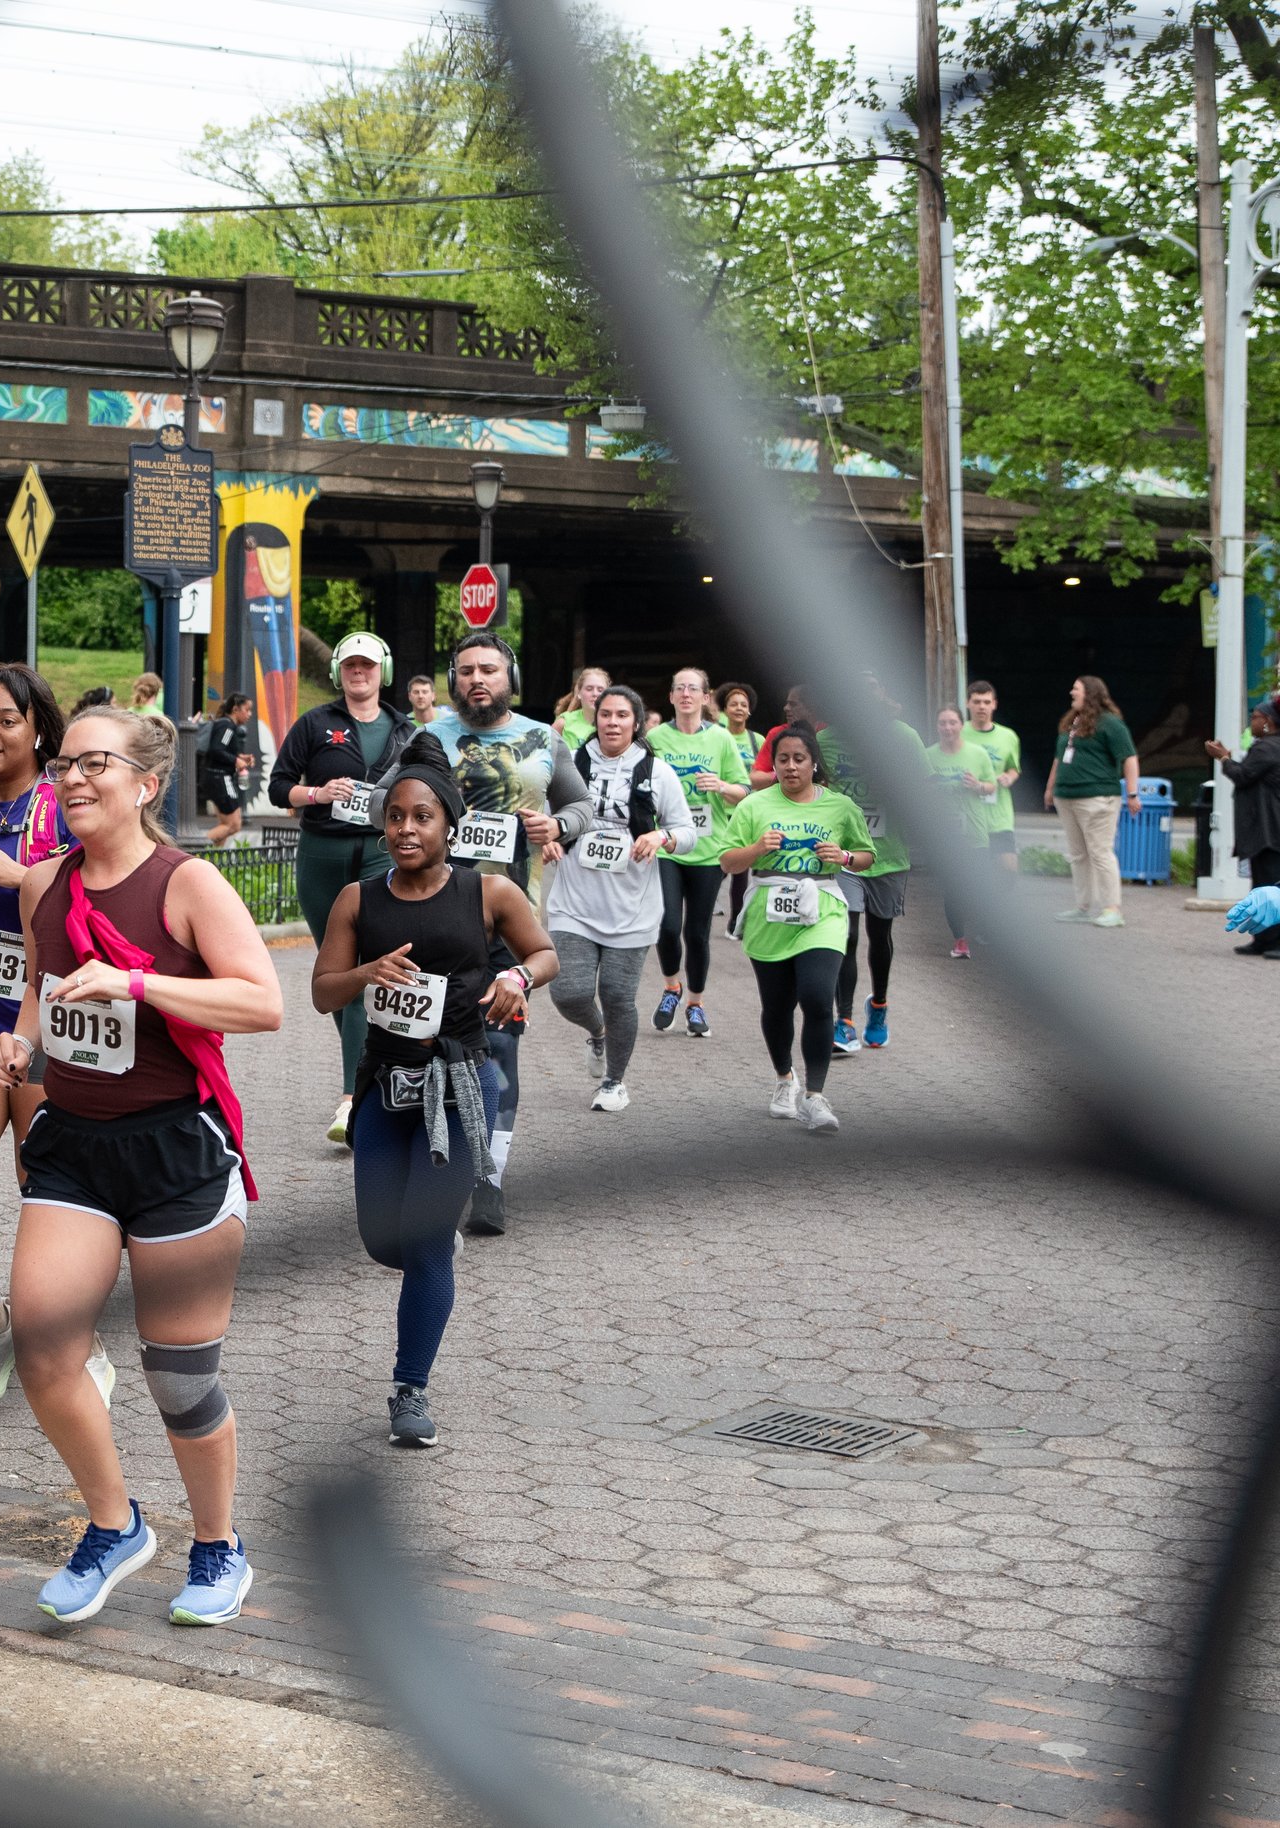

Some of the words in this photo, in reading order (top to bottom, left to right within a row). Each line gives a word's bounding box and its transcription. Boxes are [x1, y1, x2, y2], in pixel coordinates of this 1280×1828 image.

[164, 454, 182, 462] THE
[134, 460, 191, 471] PHILADELPHIA
[192, 464, 210, 472] ZOO
[133, 482, 171, 491] Chartered
[172, 484, 189, 492] 1859
[172, 477, 190, 485] First
[134, 490, 175, 499] Zoological
[181, 493, 210, 502] Society
[150, 499, 198, 509] Philadelphia.
[205, 502, 210, 510] A
[141, 514, 178, 522] zoological
[168, 508, 191, 516] refuge
[134, 520, 144, 528] the
[176, 523, 192, 531] long
[193, 523, 210, 532] been
[133, 529, 171, 537] committed
[180, 531, 210, 540] fulfilling
[149, 537, 174, 545] public
[463, 584, 494, 608] STOP
[664, 752, 686, 762] Run
[688, 752, 713, 766] Wild
[462, 826, 507, 848] 8662
[771, 822, 800, 831] Run
[803, 822, 832, 841] Wild
[587, 842, 624, 861] 8487
[374, 987, 432, 1021] 9432
[51, 1005, 121, 1049] 9013
[75, 1051, 97, 1060] NOLAN
